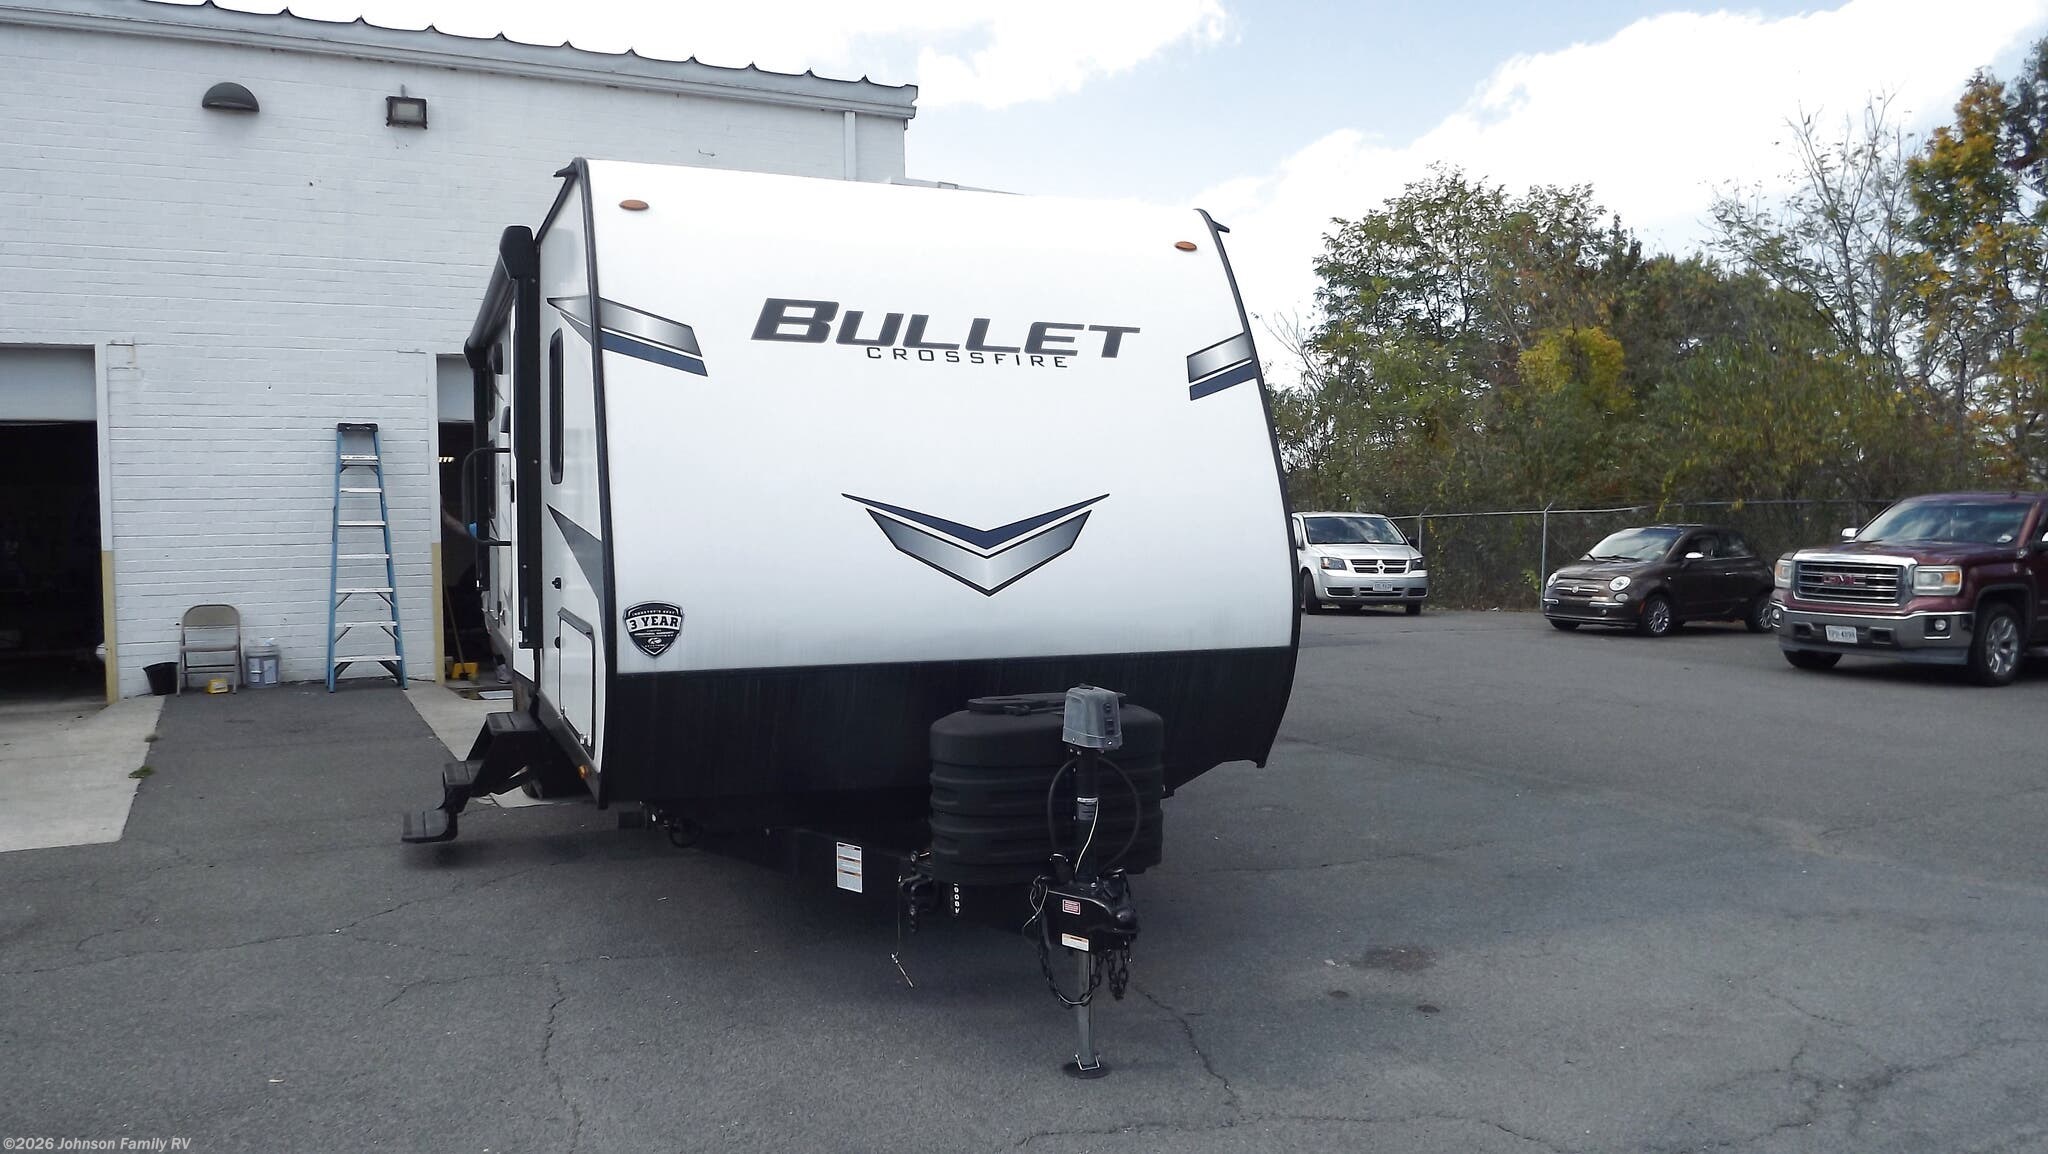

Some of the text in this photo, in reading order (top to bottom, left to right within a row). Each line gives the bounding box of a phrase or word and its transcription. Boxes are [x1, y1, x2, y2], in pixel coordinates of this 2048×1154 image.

[750, 297, 1141, 359] BULLET
[866, 346, 1068, 369] CROSSFIRE
[629, 615, 679, 630] 3 YEAR
